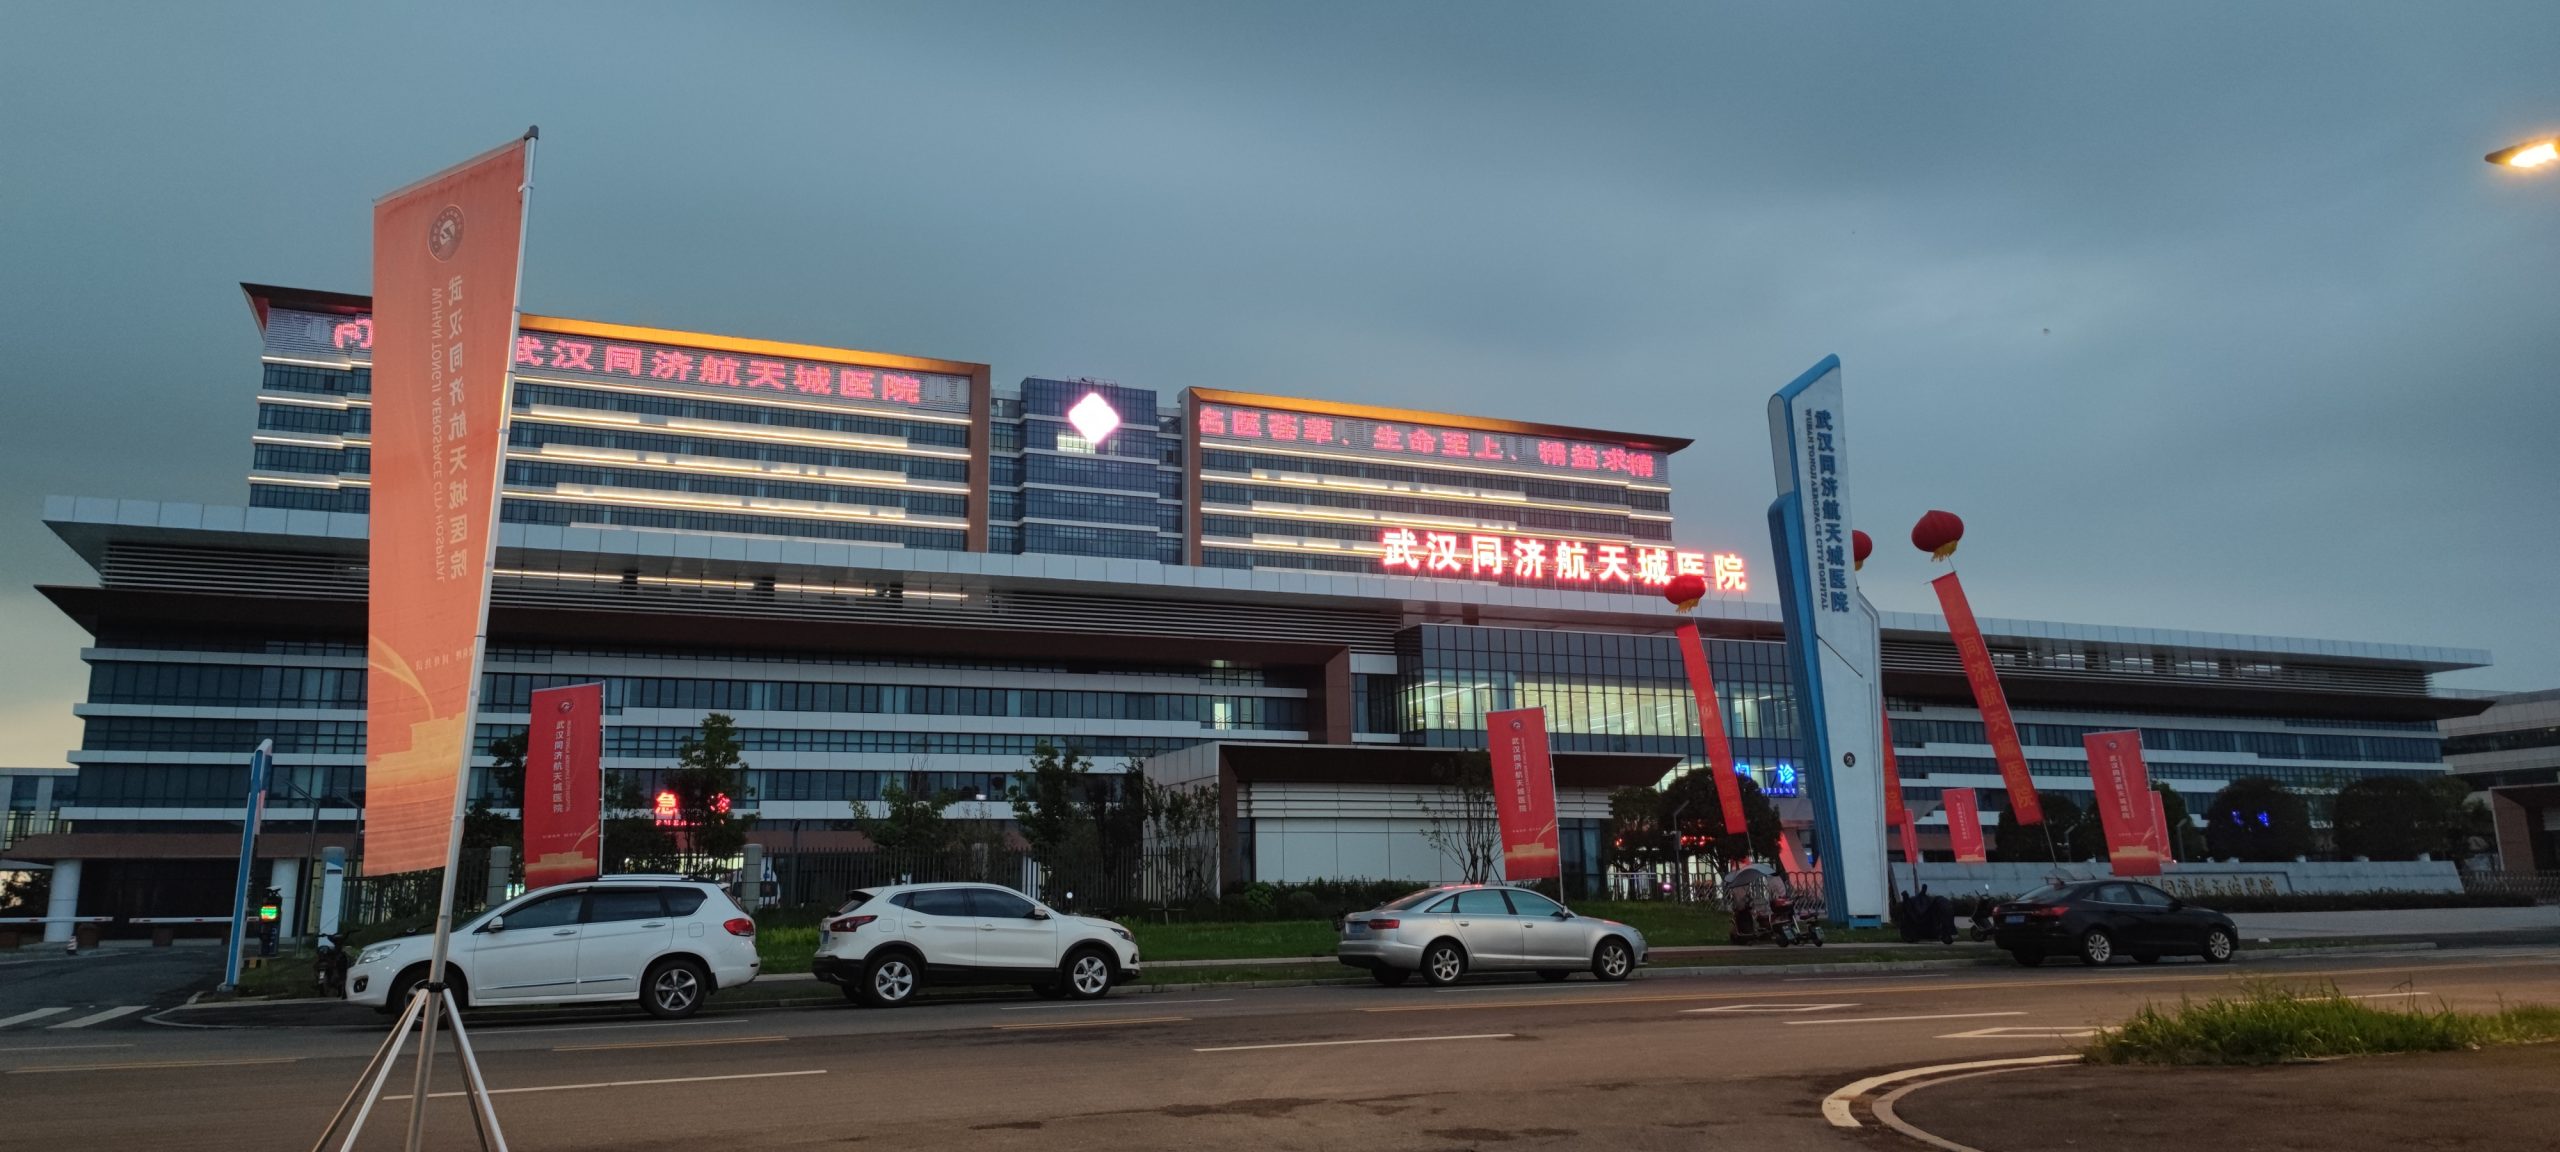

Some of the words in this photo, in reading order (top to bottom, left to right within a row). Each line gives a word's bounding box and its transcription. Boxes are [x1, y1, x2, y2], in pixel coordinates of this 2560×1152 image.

[1806, 408, 1814, 444] WUHAN
[1814, 409, 1849, 613] 武汉同济航天城医院
